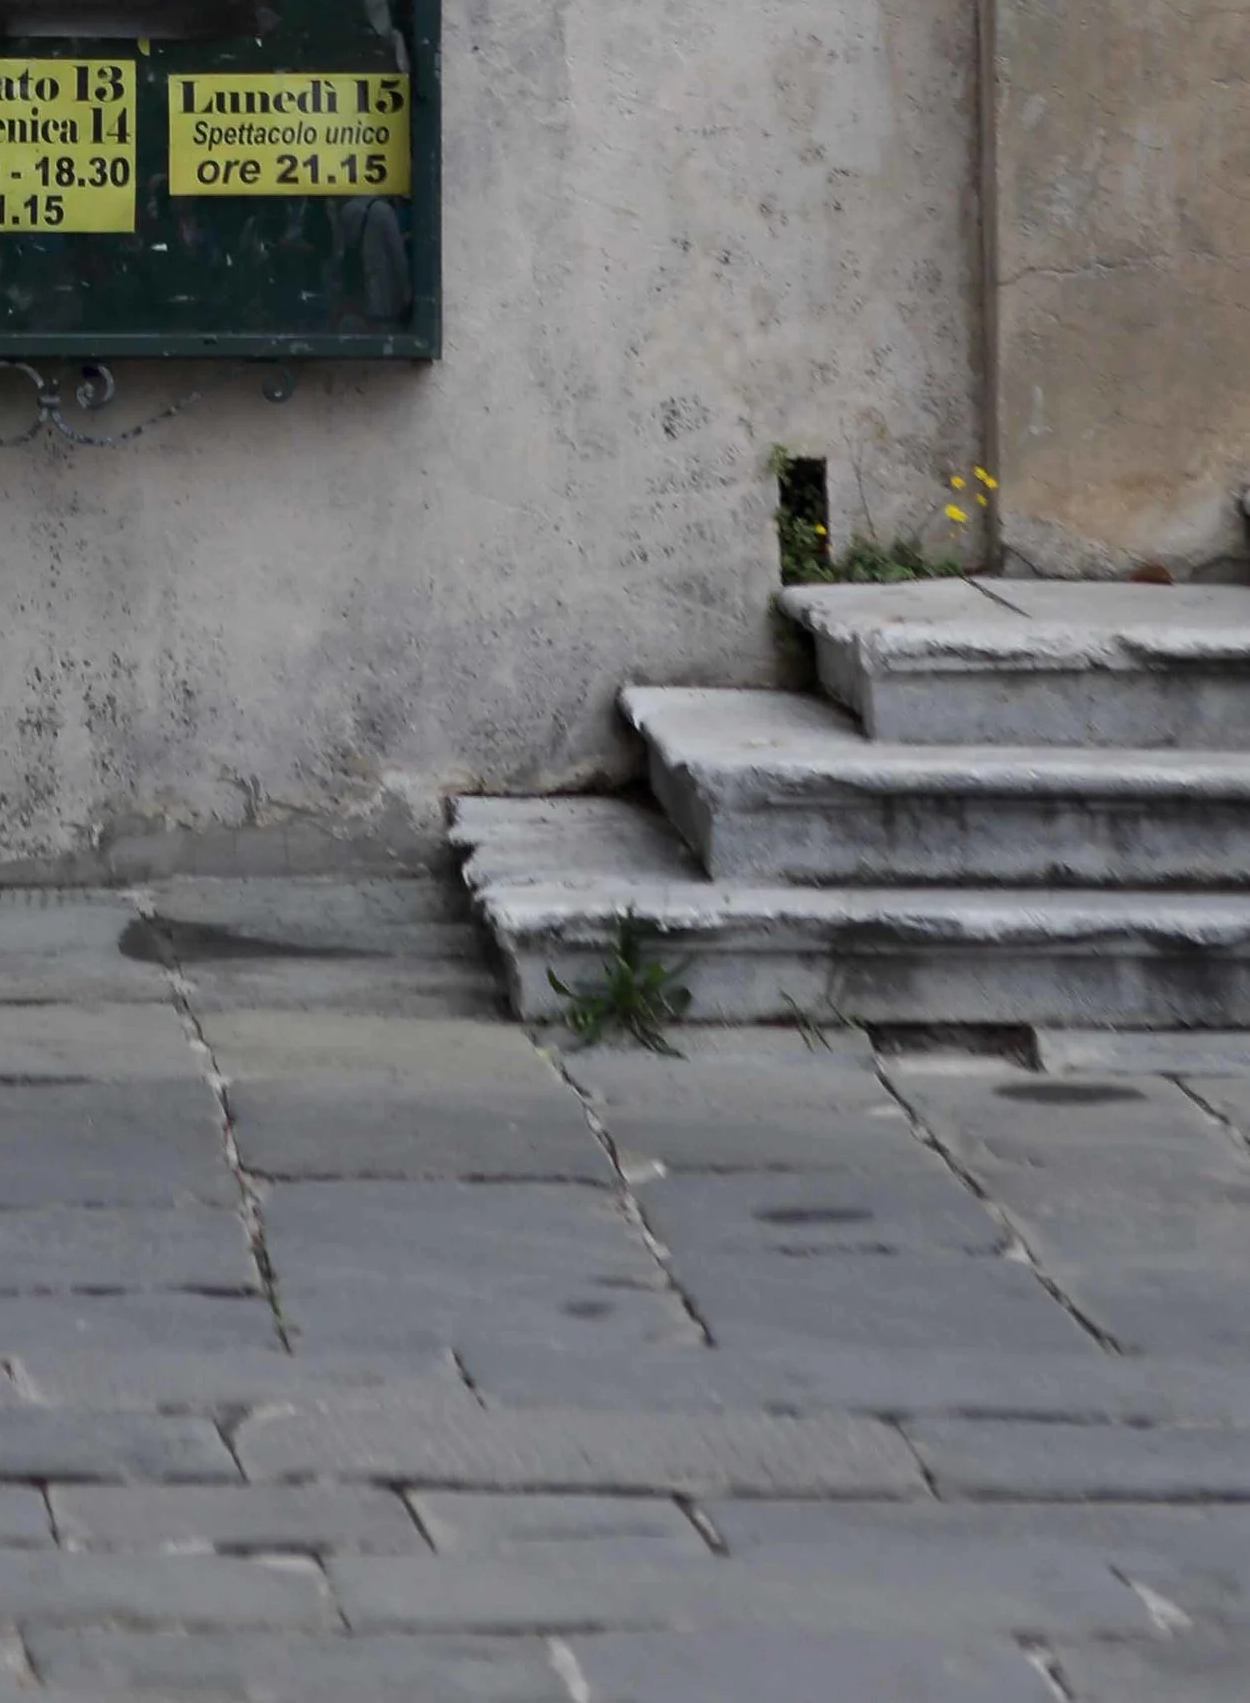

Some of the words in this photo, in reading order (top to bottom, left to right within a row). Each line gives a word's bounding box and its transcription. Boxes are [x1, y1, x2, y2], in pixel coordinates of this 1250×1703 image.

[73, 65, 125, 103] 13
[178, 79, 338, 114] Lunedì
[354, 79, 404, 114] 15
[90, 106, 131, 145] 14
[193, 120, 317, 151] Spettacolo
[325, 121, 390, 145] unico
[35, 156, 130, 188] 18.30
[196, 158, 261, 185] ore
[276, 154, 387, 185] 21.15
